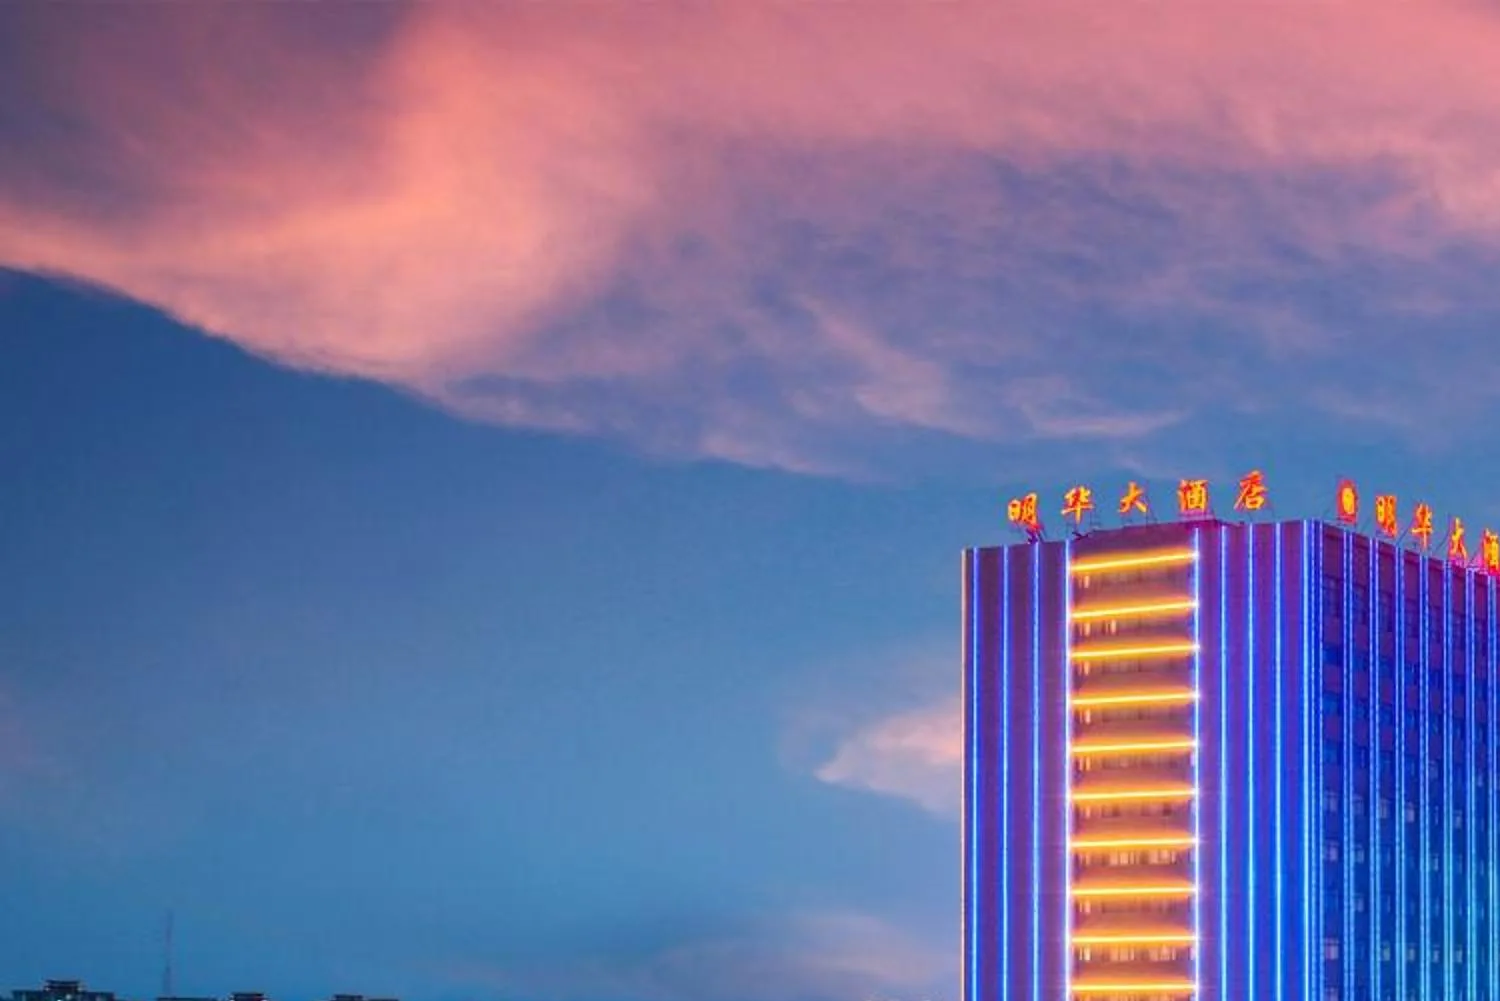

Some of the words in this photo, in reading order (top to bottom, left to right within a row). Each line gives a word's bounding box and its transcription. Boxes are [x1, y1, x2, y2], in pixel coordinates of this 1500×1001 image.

[1007, 470, 1267, 526] 明华大酒店
